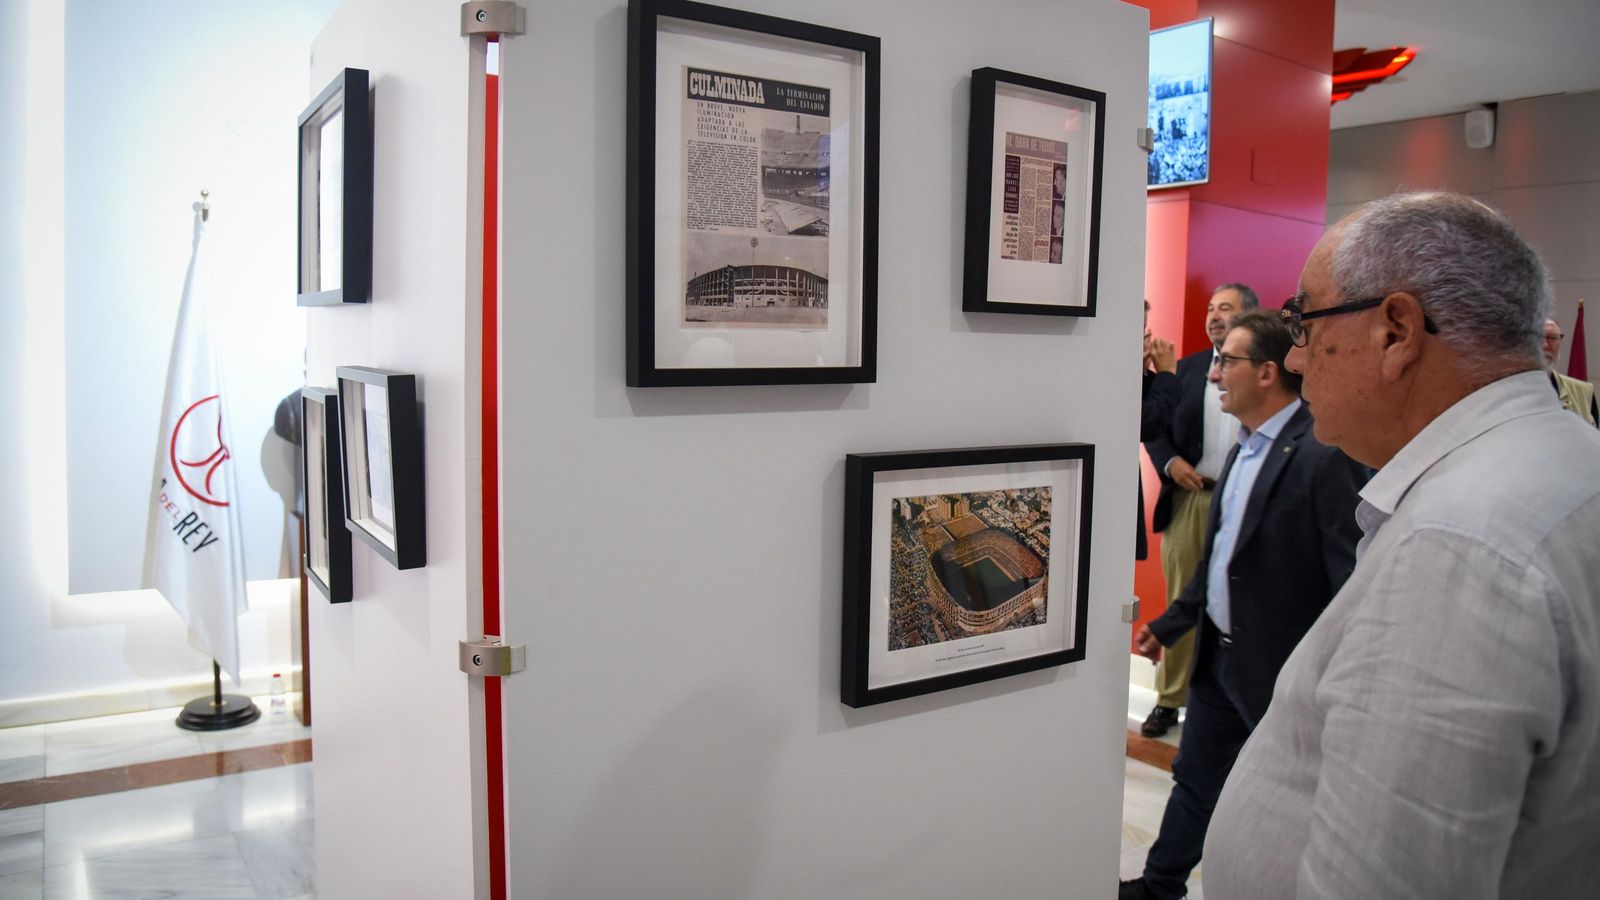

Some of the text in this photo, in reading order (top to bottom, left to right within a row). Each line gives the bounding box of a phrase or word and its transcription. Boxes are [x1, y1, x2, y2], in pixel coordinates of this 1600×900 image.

[689, 71, 765, 104] CULMINADA
[776, 87, 826, 102] LA TERMINACION
[786, 98, 825, 111] DEL ESTADIO
[697, 116, 725, 125] ADAPTADA
[697, 123, 729, 133] EXIGENCIAS
[739, 135, 756, 143] COLOR
[1014, 135, 1030, 150] OBRA
[159, 492, 219, 552] DEL REY
